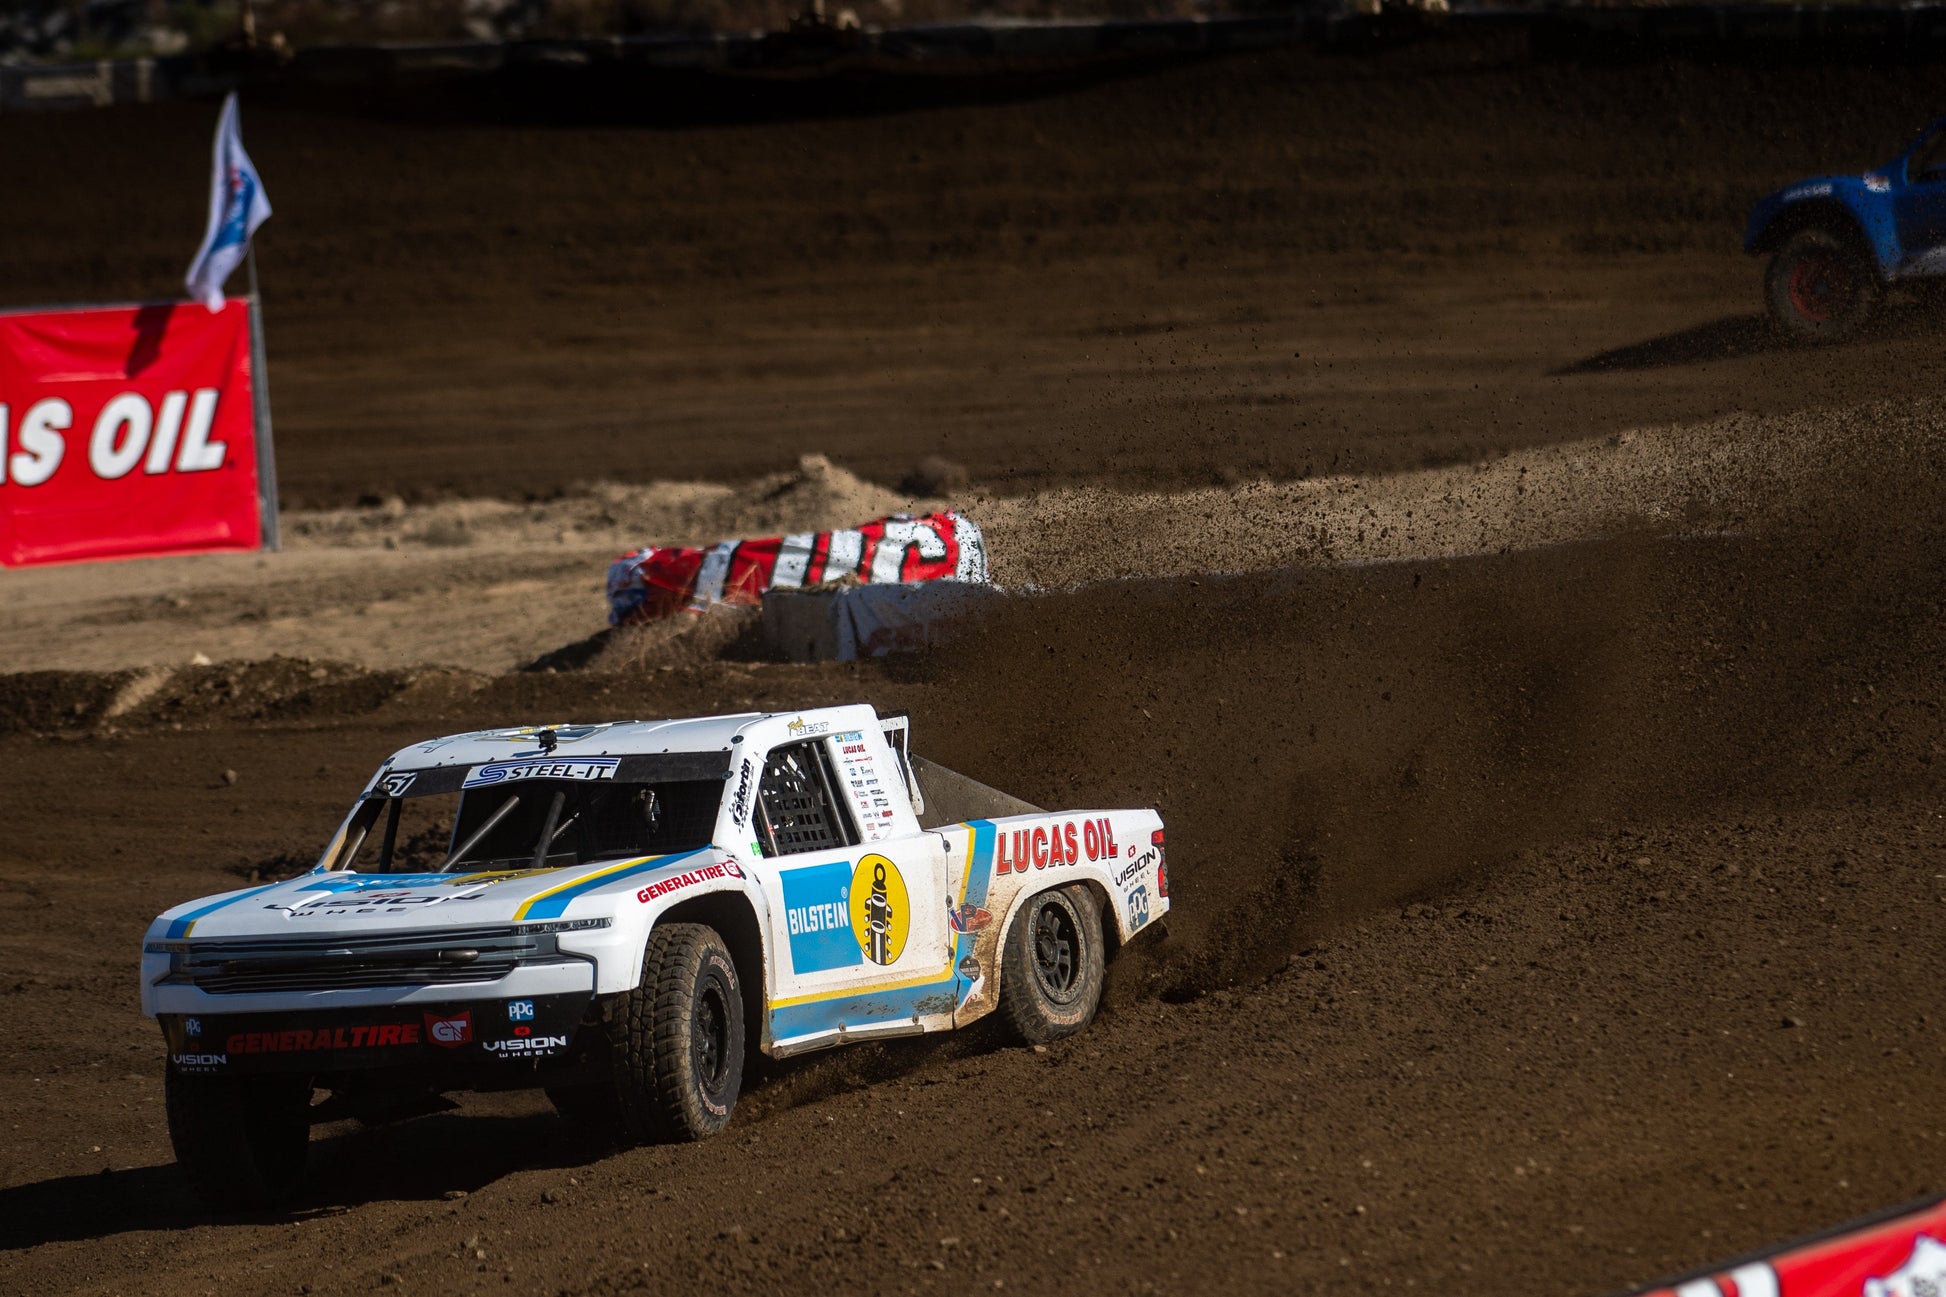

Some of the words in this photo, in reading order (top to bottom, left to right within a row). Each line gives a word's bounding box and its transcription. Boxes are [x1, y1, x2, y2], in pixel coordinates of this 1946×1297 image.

[0, 397, 73, 487] S
[88, 388, 227, 480] OIL
[507, 764, 613, 780] STEEL-IT
[996, 821, 1079, 876] LUCAS
[1083, 818, 1118, 861] OIL
[1115, 848, 1156, 887] VISION
[1123, 869, 1151, 893] WHEEL
[289, 906, 407, 918] WHEE
[788, 901, 849, 935] BILSTEIN
[949, 904, 978, 932] VP
[1129, 892, 1148, 927] PPG
[508, 1002, 534, 1020] PPG
[186, 1018, 201, 1036] PPG
[431, 1020, 468, 1042] GT
[483, 1035, 567, 1052] VISION
[499, 1049, 555, 1058] WHEEL
[172, 1053, 227, 1065] VISION
